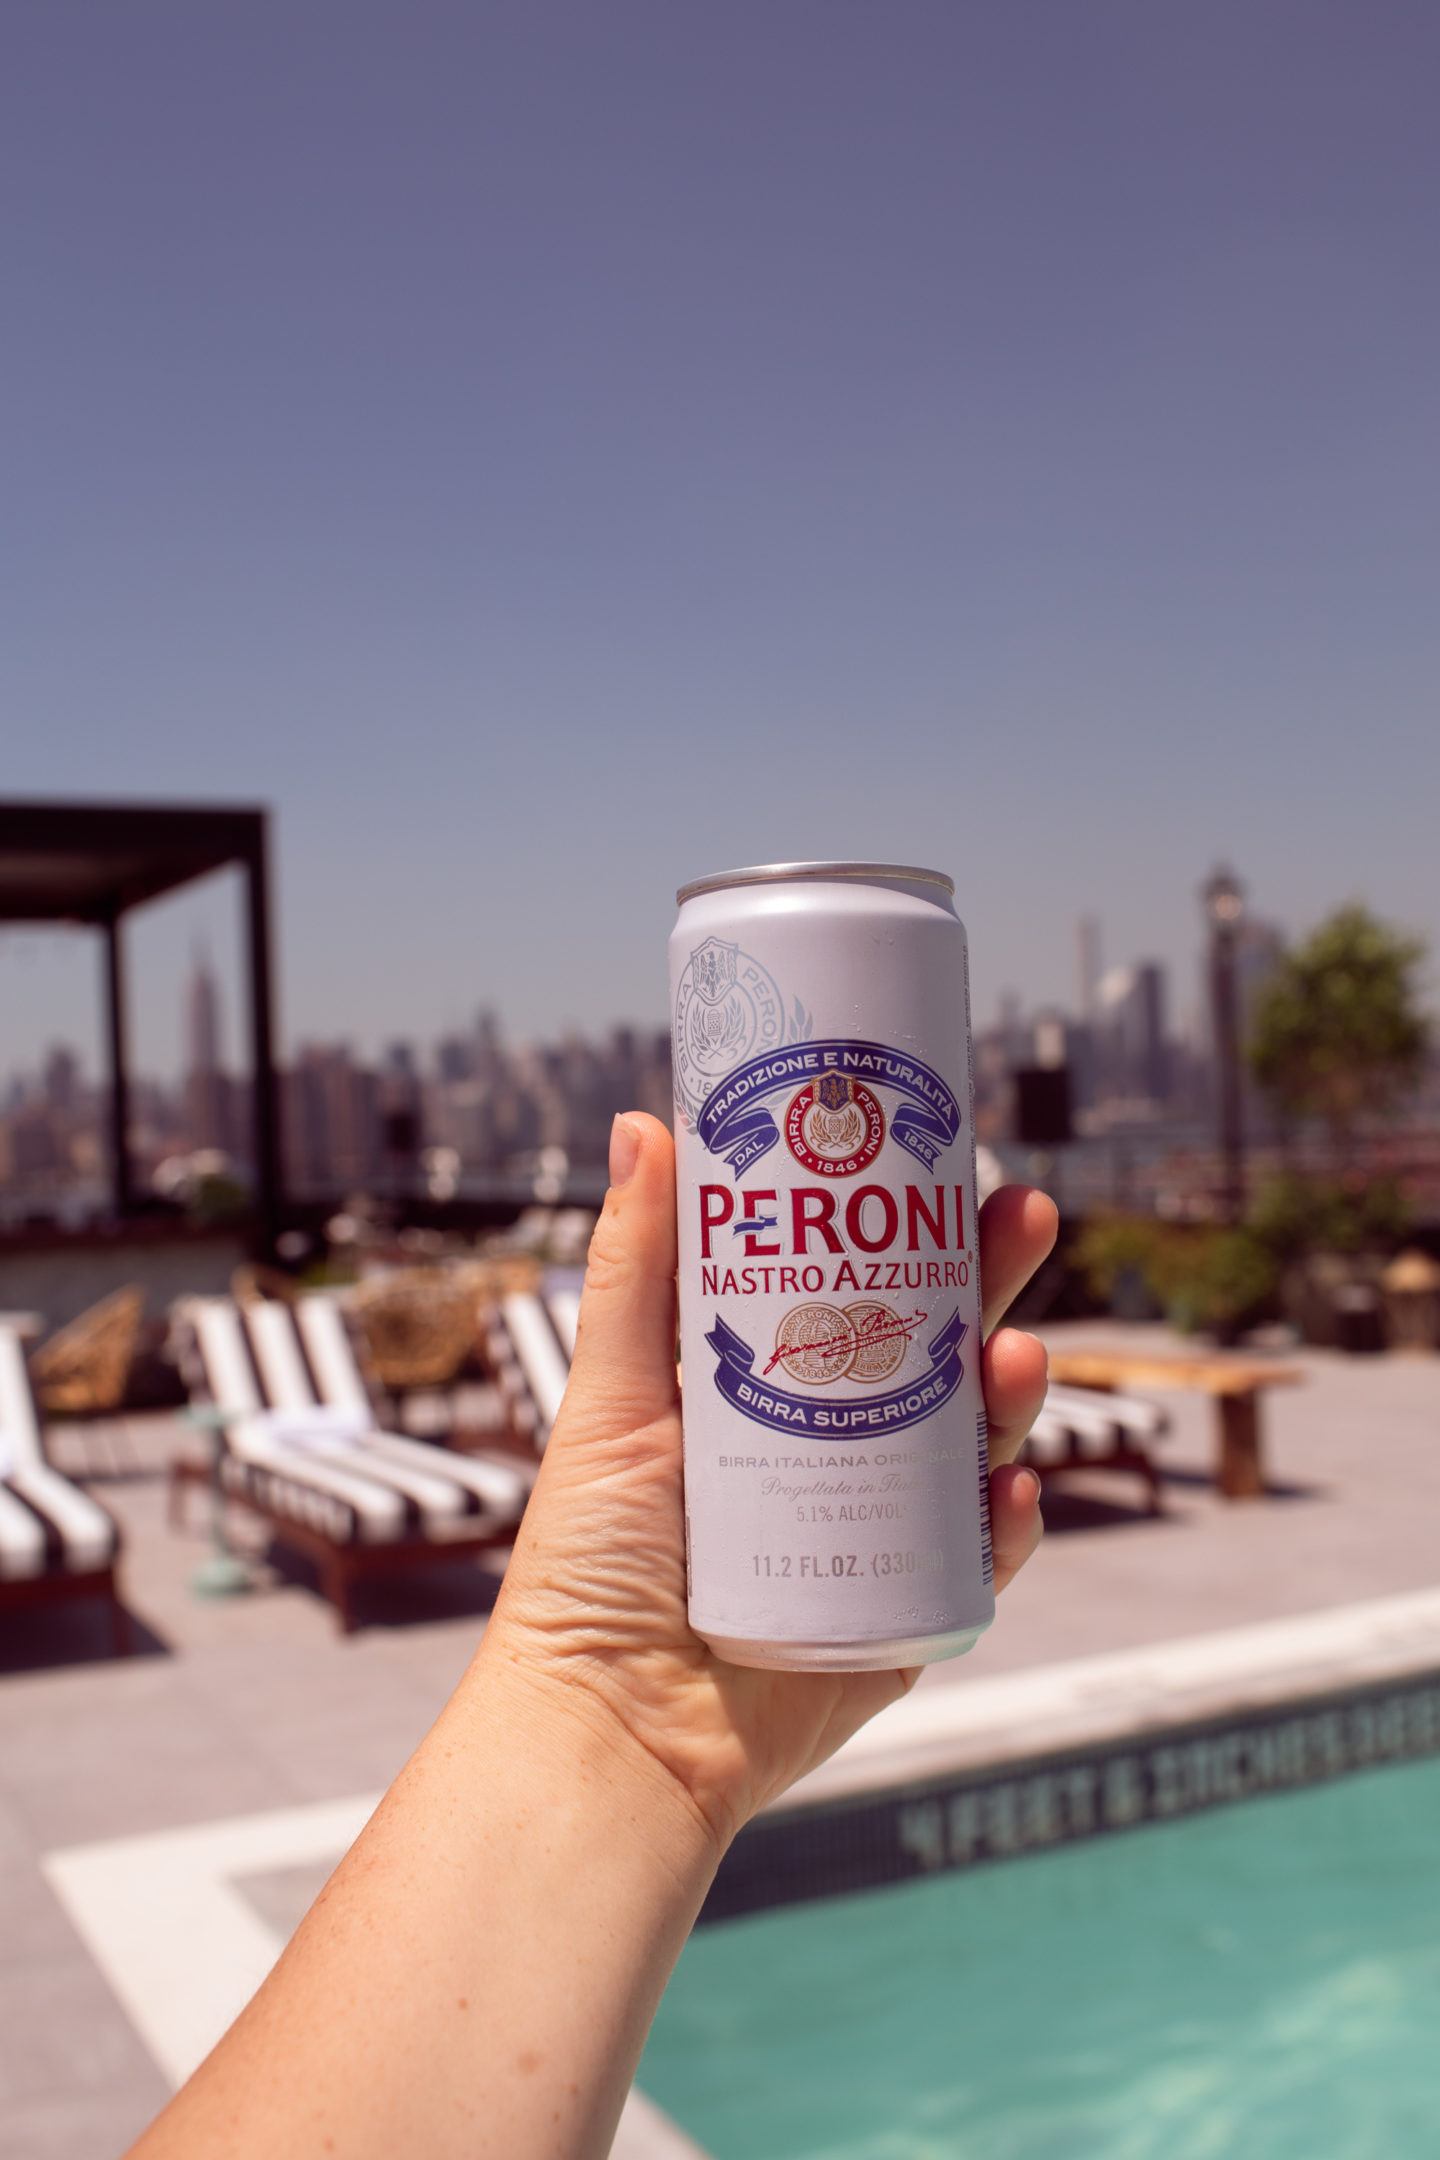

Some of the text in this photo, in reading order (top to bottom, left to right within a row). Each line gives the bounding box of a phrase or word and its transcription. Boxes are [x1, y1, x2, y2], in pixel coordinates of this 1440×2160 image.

[741, 966, 778, 1055] PERON
[706, 1053, 818, 1125] TRADIZIONE
[824, 1052, 838, 1066] E
[789, 1091, 881, 1157] BIRRA PERONI
[734, 1140, 764, 1167] DAL
[904, 1131, 933, 1160] 1846
[816, 1160, 857, 1173] 1846
[699, 1184, 966, 1259] PERONI
[702, 1264, 825, 1296] NASTRO
[795, 1310, 837, 1326] PERONI
[736, 1376, 948, 1427] BIRRA SUPERIORE
[718, 1455, 770, 1469] BIRRA
[775, 1454, 867, 1469] ITALIANA
[761, 1476, 852, 1502] Progettata
[857, 1478, 875, 1495] in
[796, 1505, 834, 1523] 5.1%
[751, 1554, 792, 1579] 11.2
[799, 1553, 865, 1579] FL.OZ.
